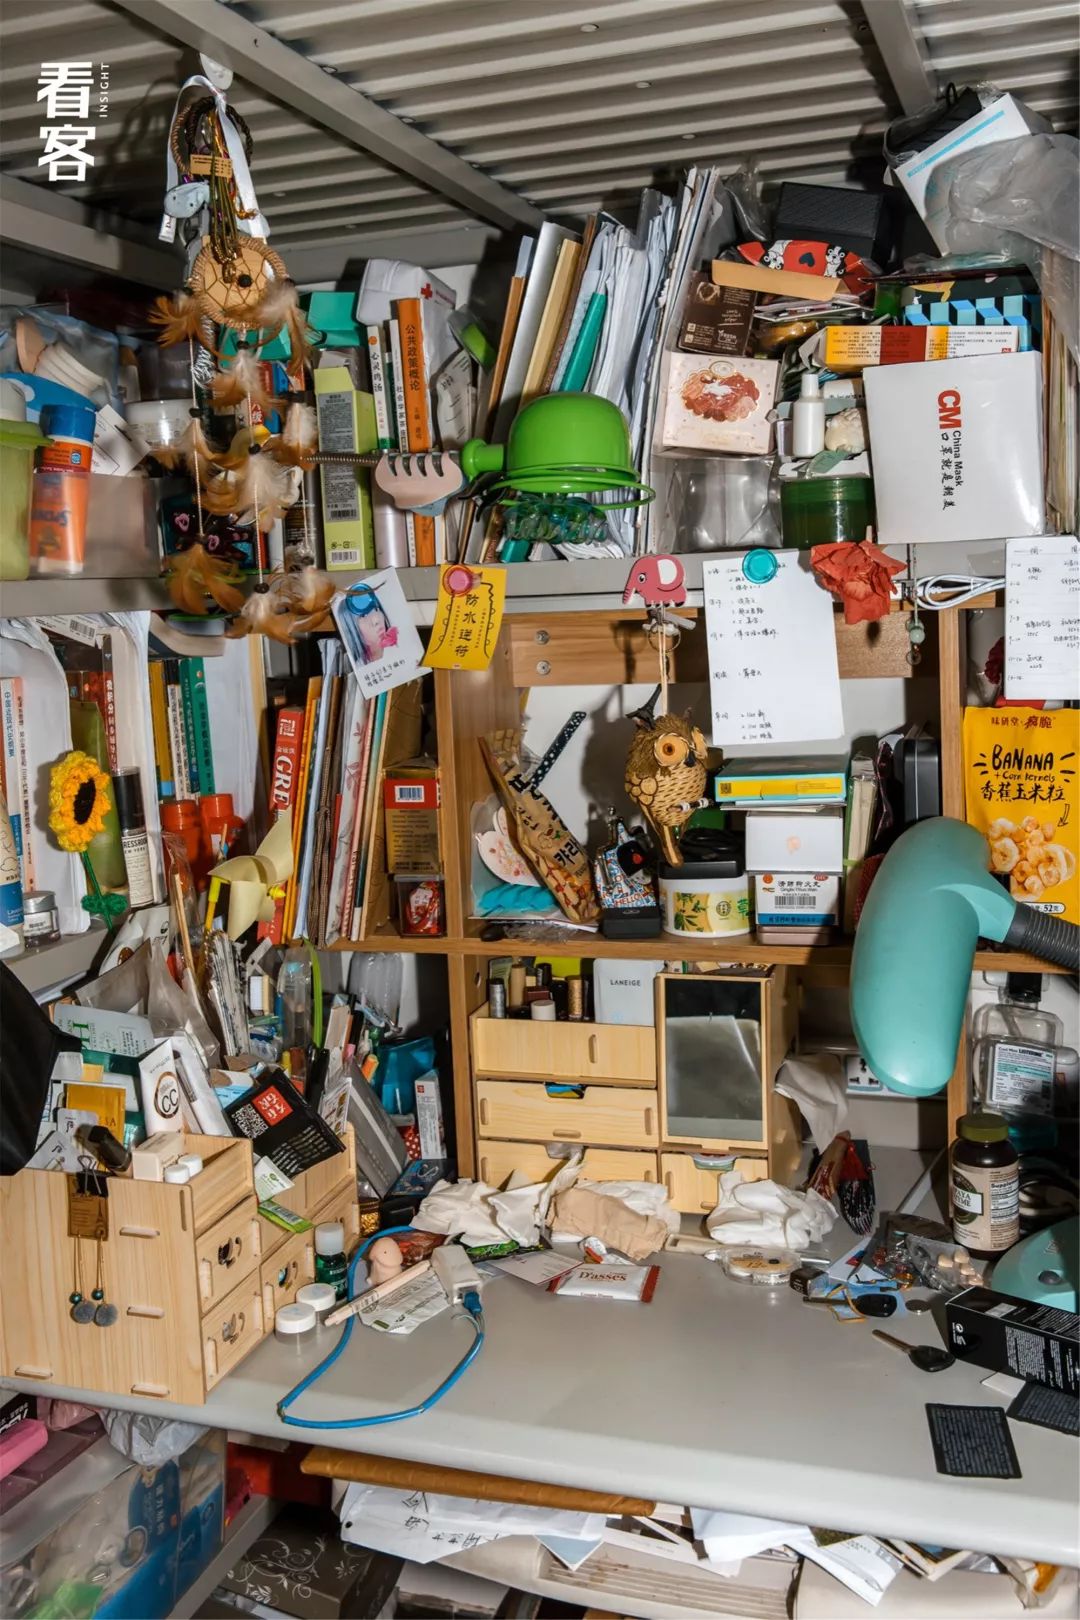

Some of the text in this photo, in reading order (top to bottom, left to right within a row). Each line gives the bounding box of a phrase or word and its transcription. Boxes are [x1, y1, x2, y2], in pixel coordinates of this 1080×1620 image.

[406, 324, 421, 391] 公共政策概论
[938, 389, 962, 429] CM
[953, 430, 964, 487] China Mask
[991, 744, 1054, 771] BANANA
[273, 755, 293, 805] GRE
[981, 782, 1065, 804] 香蕉玉米粒
[1002, 772, 1022, 781] Corn
[1025, 772, 1056, 783] kernels
[161, 1088, 179, 1113] CC
